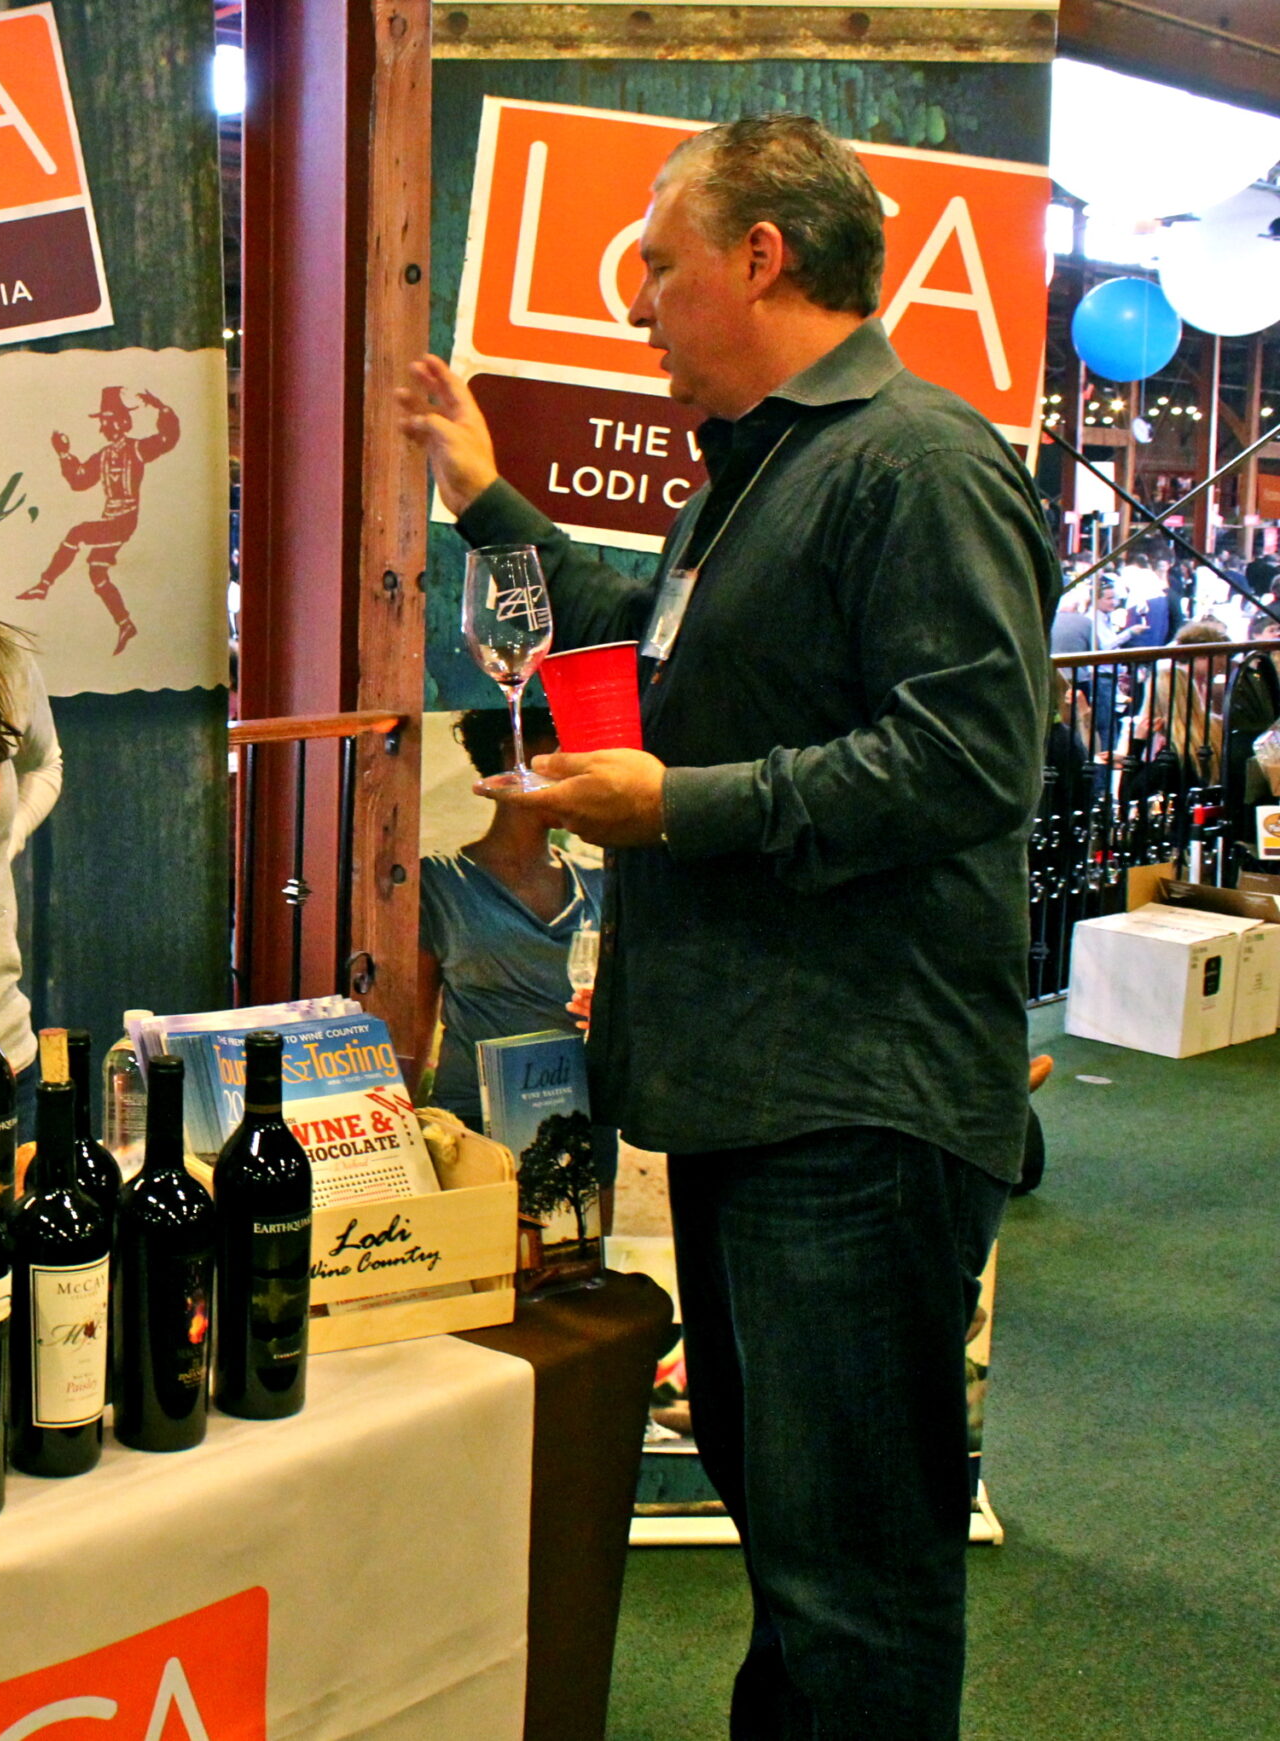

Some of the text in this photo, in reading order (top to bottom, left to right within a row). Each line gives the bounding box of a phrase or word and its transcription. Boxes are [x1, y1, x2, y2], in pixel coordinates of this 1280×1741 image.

[588, 417, 671, 457] THE
[548, 462, 649, 504] LODI
[284, 1035, 298, 1044] TO
[299, 1031, 324, 1043] WINE
[326, 1024, 370, 1039] COUNTRY
[303, 1039, 399, 1079] Tasting
[520, 1055, 571, 1091] Lodi
[371, 1111, 394, 1133] &
[306, 1134, 400, 1163] HOCOLATE
[328, 1214, 412, 1257] Lodi
[357, 1246, 442, 1271] Country
